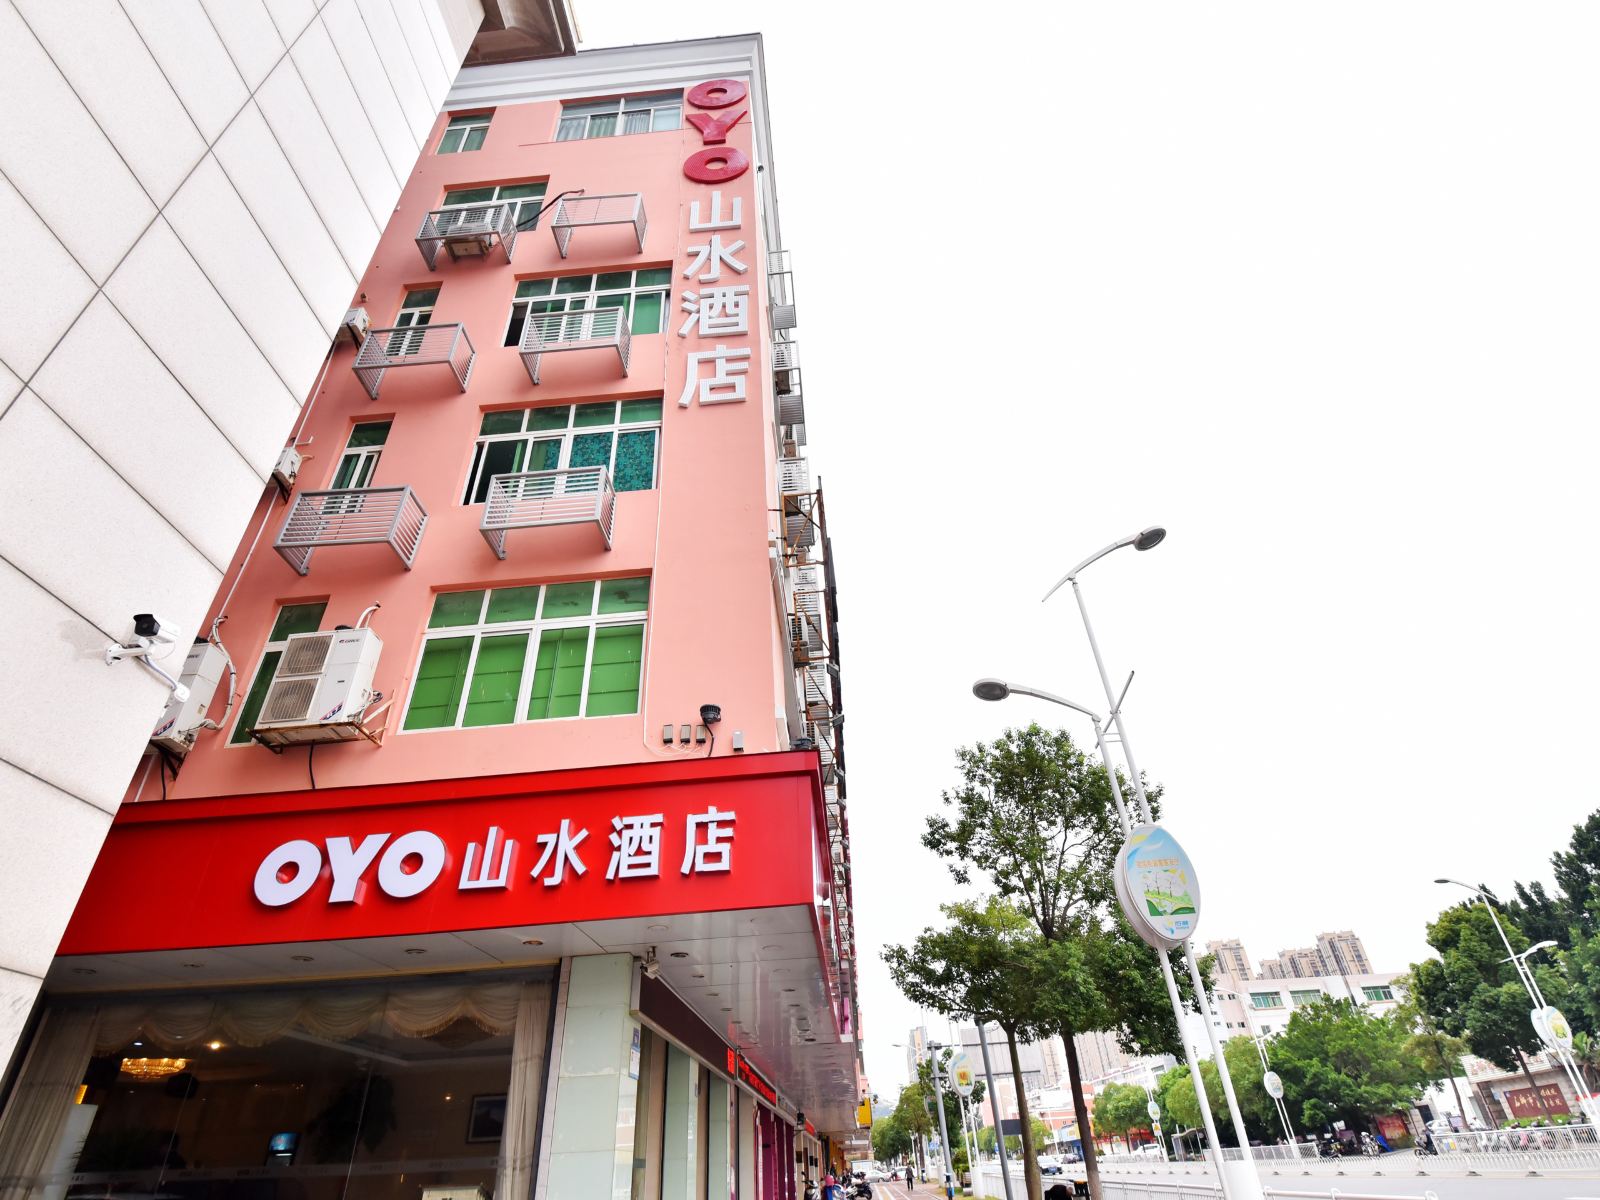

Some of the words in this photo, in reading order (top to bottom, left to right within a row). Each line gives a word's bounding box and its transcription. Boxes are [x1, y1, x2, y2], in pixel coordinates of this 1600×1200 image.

[683, 79, 749, 184] OYO
[678, 190, 750, 408] 山水酒店
[253, 830, 448, 906] OYO
[458, 806, 737, 889] 山水酒店
